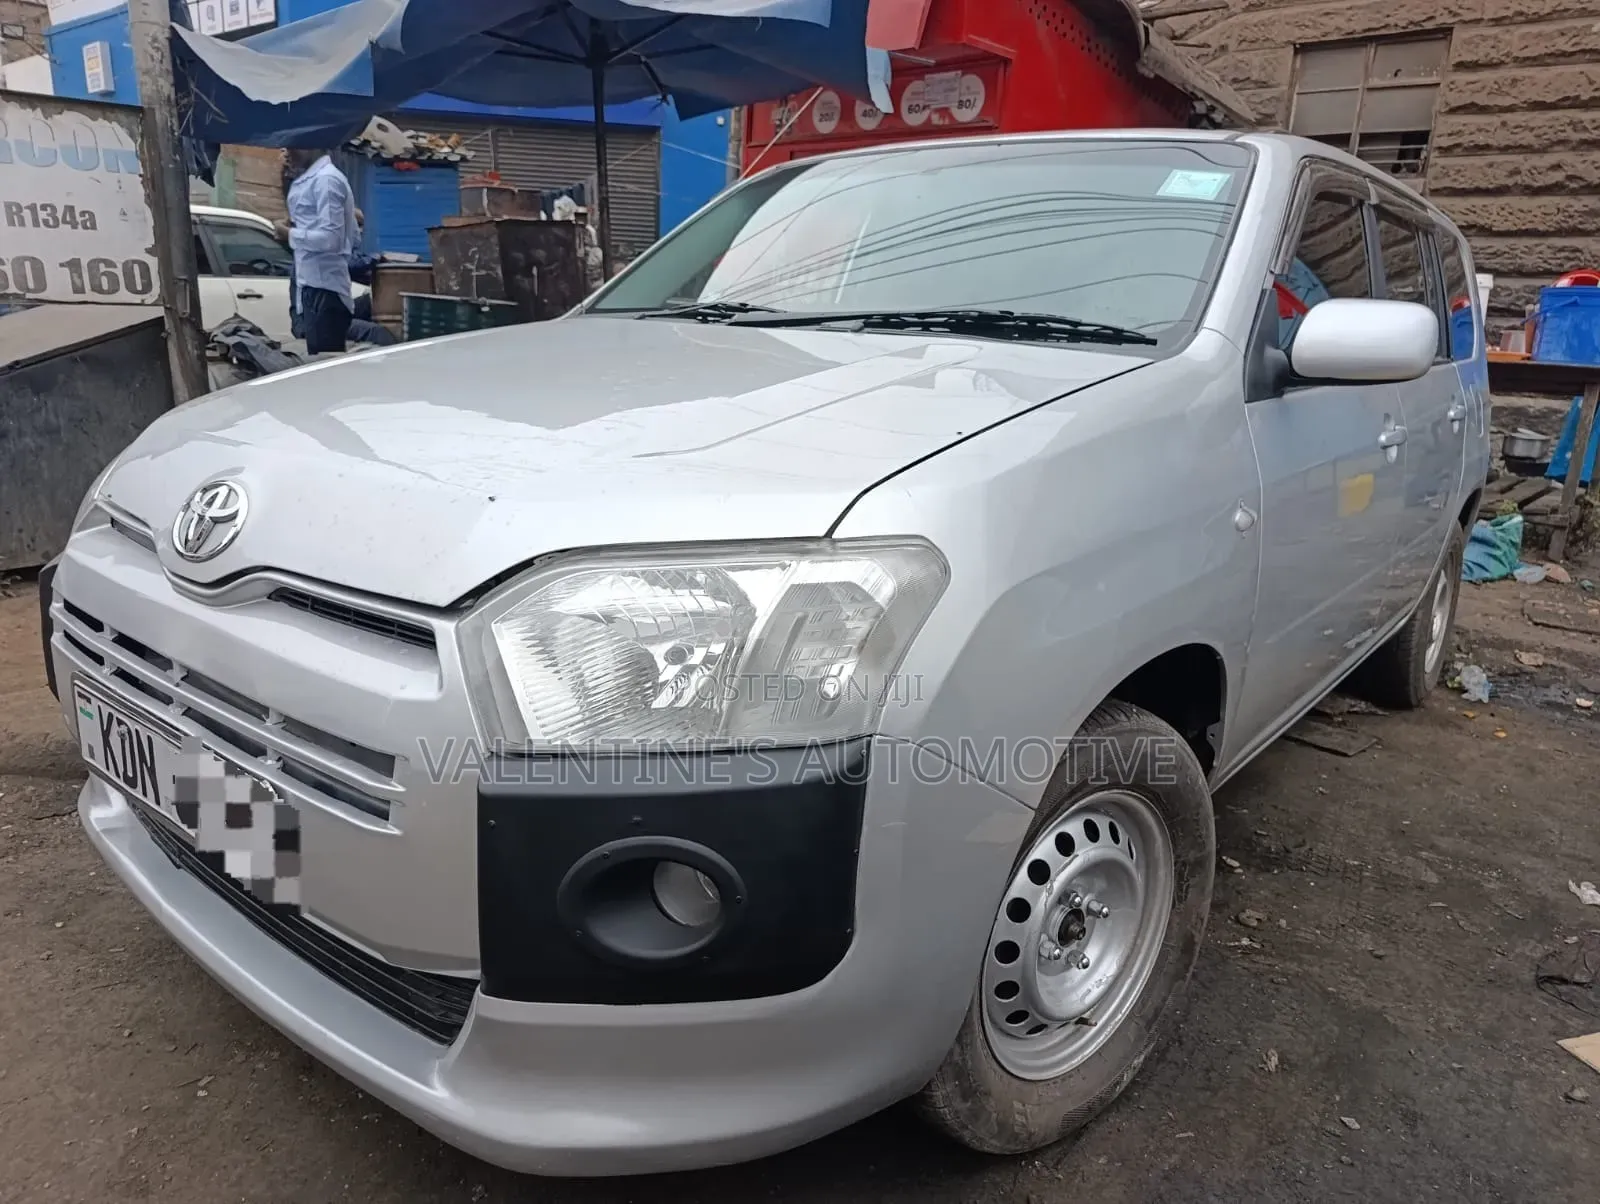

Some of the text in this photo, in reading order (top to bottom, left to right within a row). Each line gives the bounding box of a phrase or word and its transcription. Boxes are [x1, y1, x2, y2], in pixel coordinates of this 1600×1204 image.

[3, 201, 98, 231] R134a
[59, 257, 153, 296] 160
[98, 703, 161, 807] KDN
